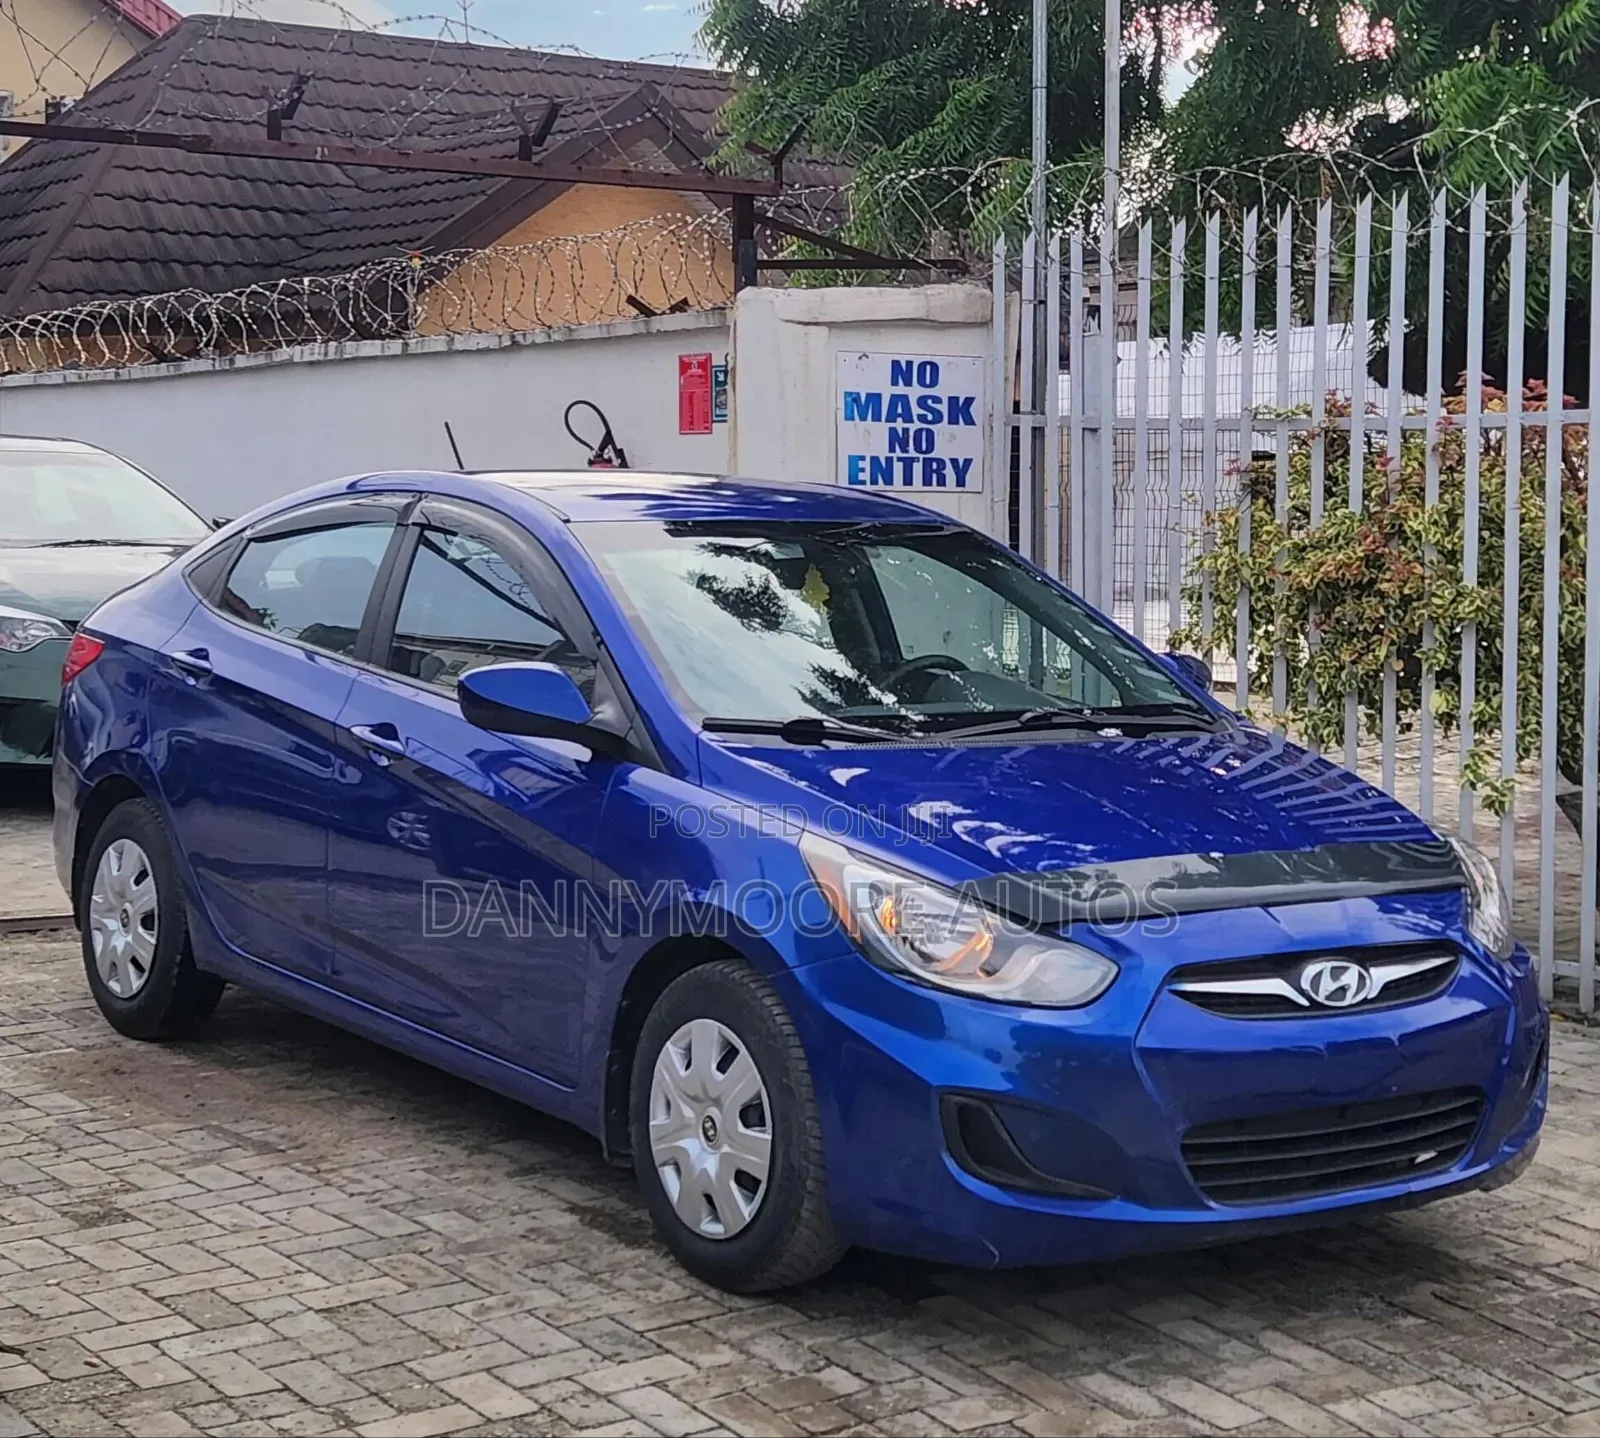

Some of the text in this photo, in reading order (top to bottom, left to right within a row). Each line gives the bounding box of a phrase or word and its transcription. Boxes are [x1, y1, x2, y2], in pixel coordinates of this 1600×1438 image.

[890, 359, 940, 389] NO
[843, 391, 977, 426] MASK
[888, 426, 936, 455] NO
[847, 454, 974, 488] ENTRY
